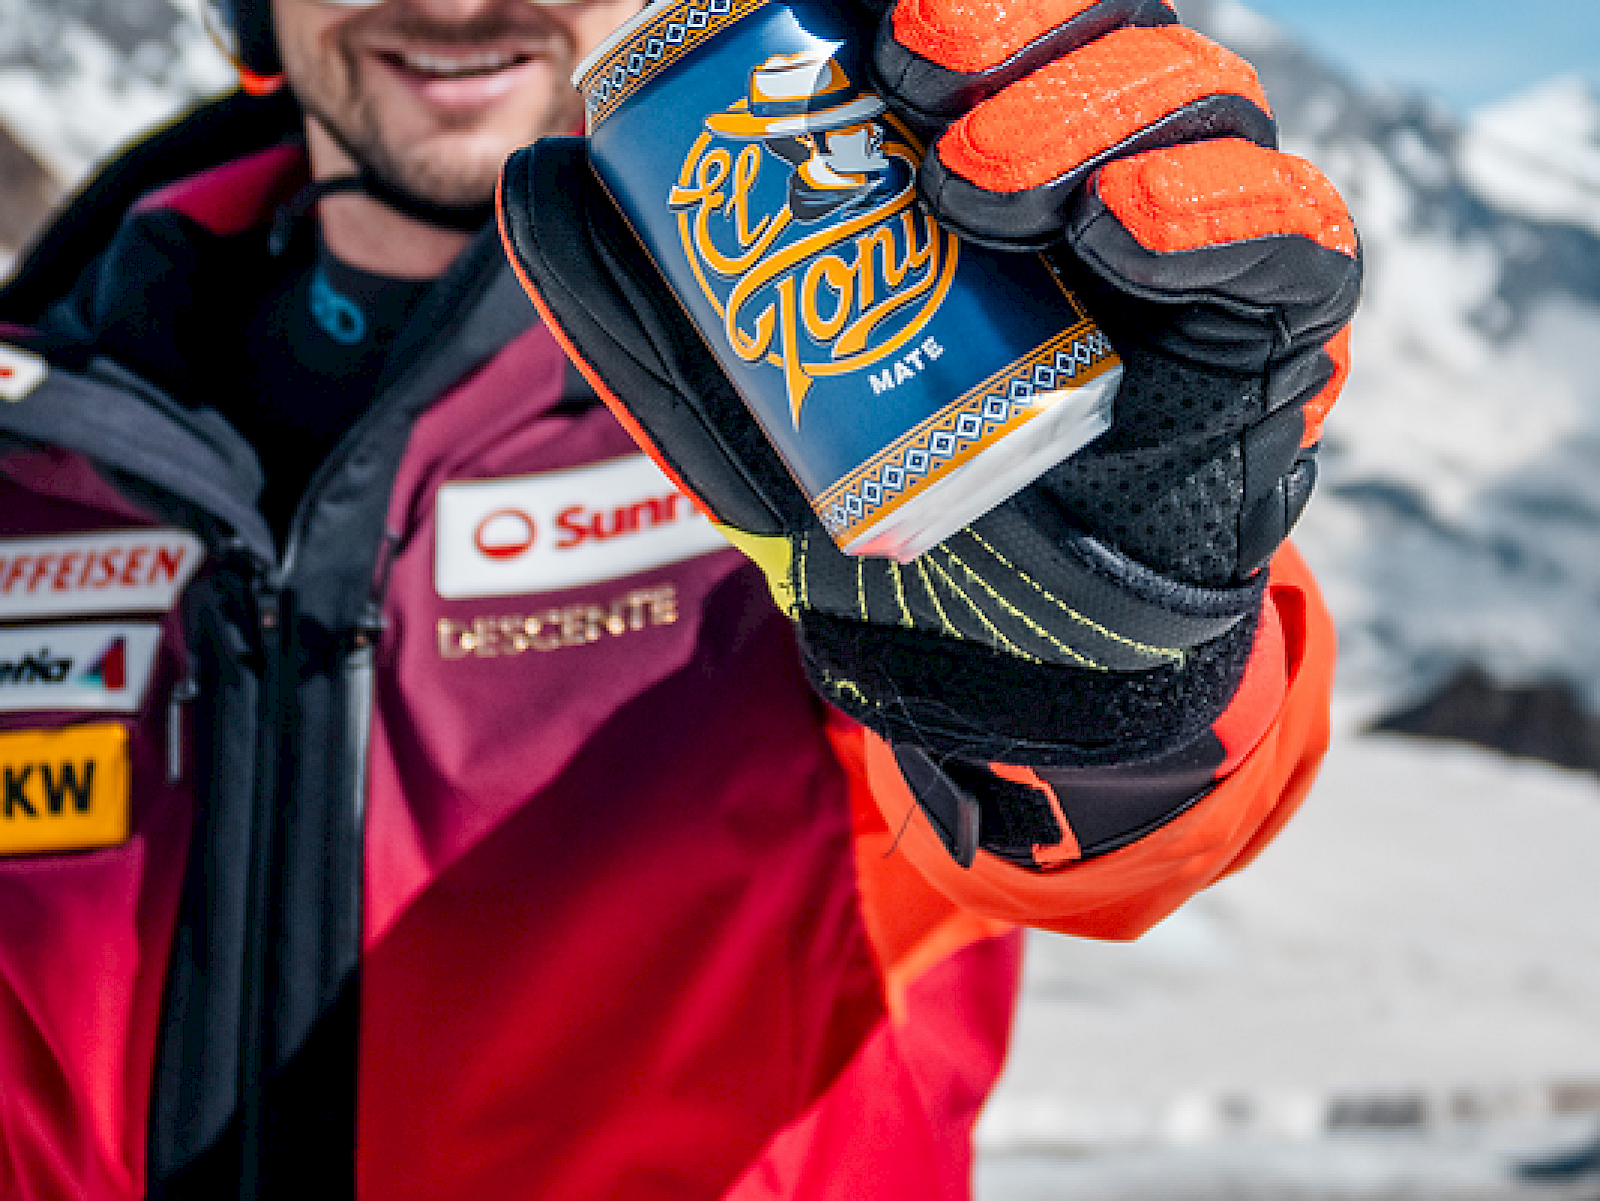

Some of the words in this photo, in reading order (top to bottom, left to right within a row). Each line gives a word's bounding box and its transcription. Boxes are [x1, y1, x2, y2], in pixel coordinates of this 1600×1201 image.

[725, 185, 940, 432] Tony
[867, 335, 944, 395] MATE
[553, 491, 698, 548] Sunr
[437, 585, 678, 660] DESCENTE
